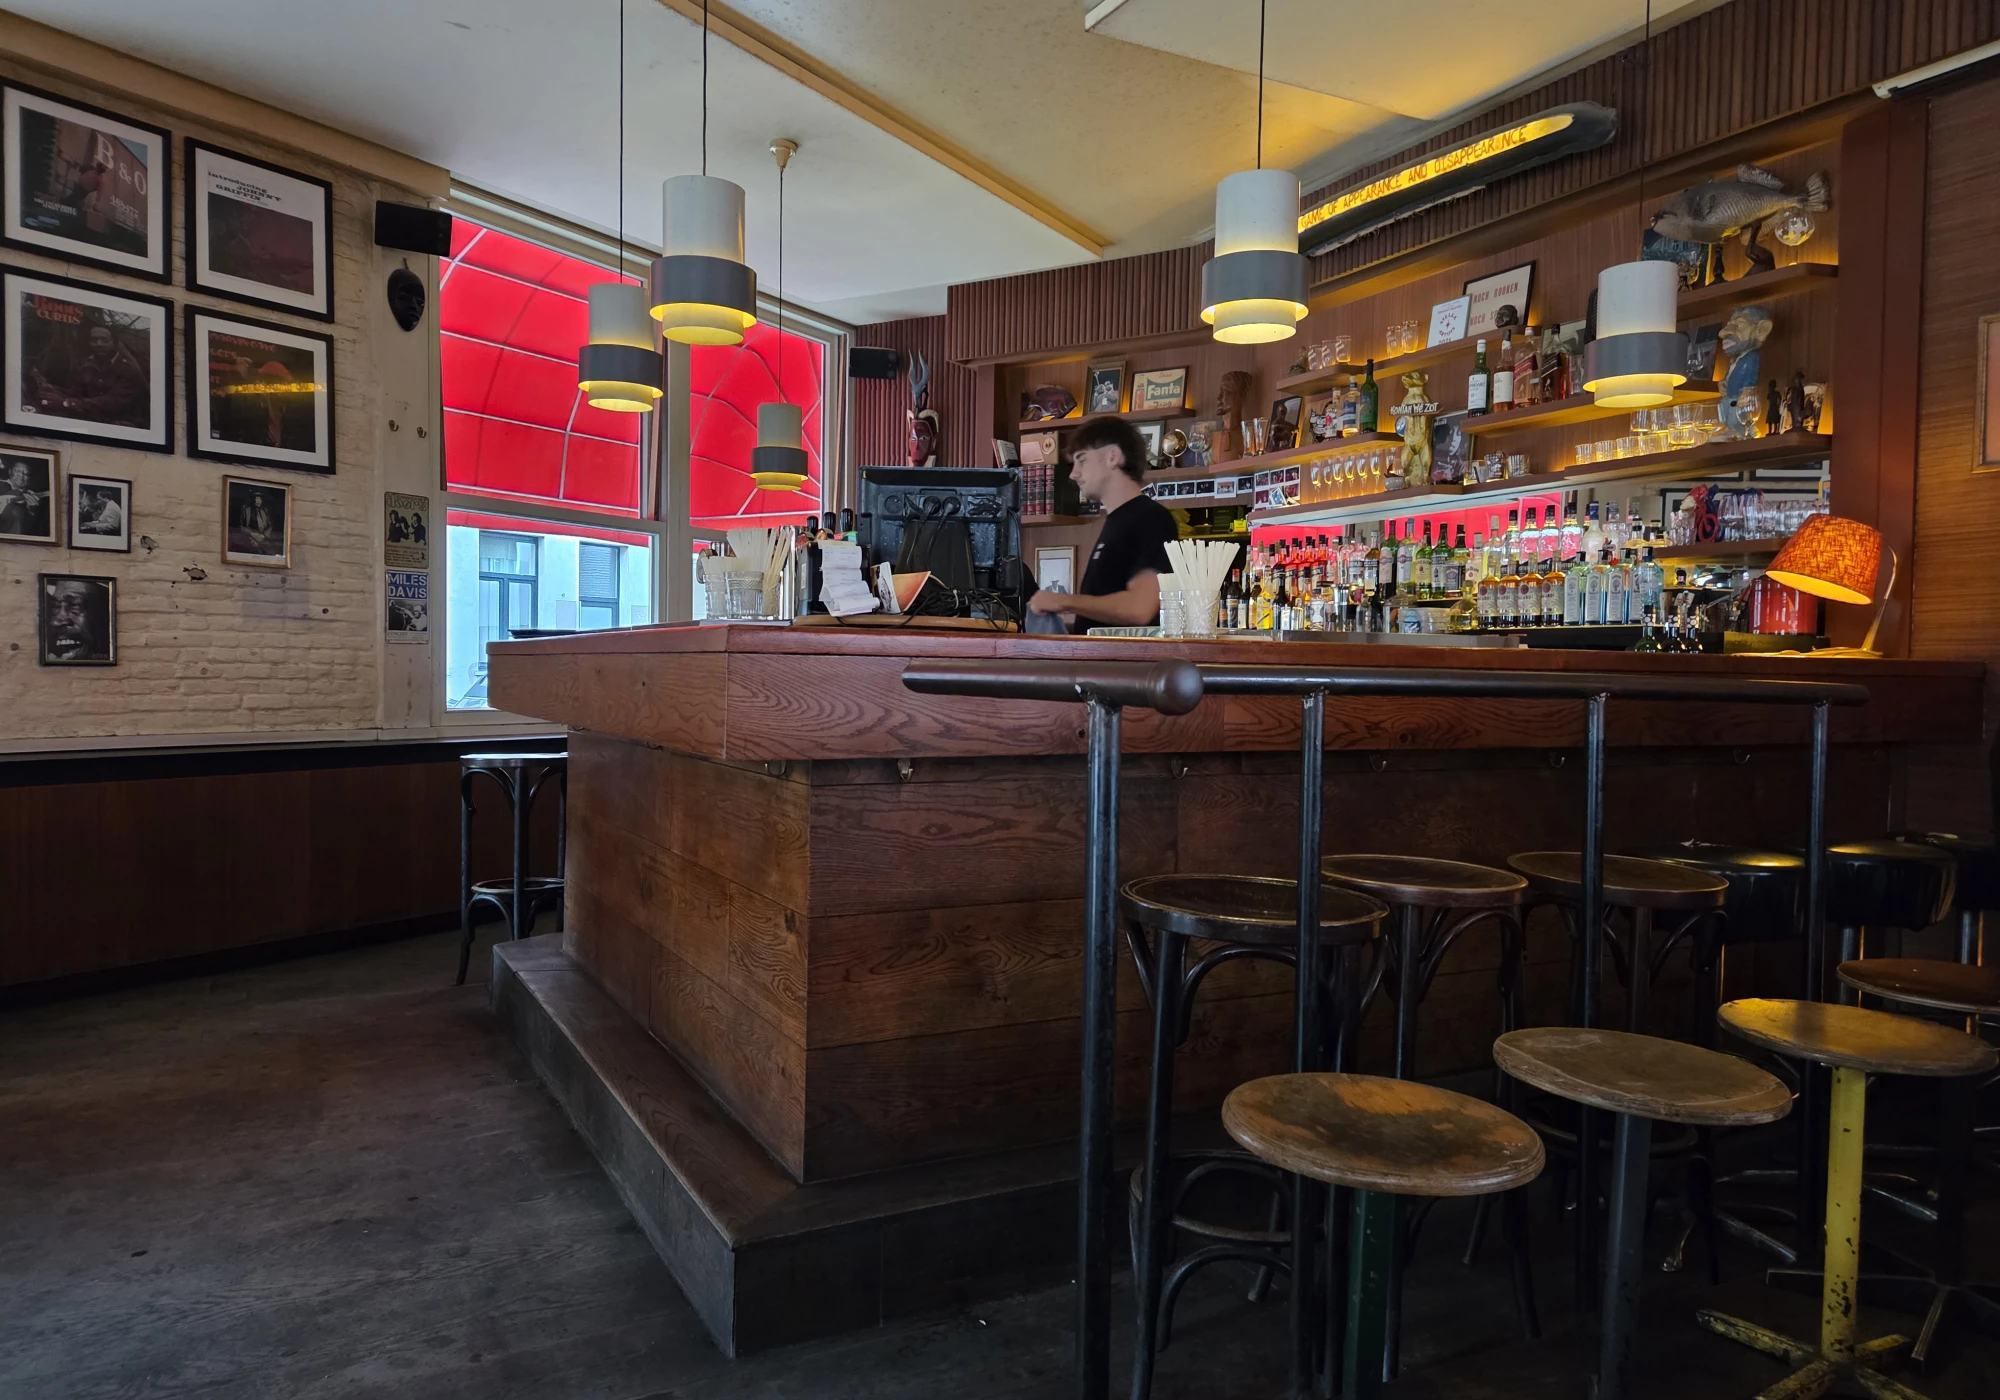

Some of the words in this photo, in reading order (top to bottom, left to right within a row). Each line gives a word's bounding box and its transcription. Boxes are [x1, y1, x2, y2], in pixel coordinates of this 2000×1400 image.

[94, 130, 115, 170] B
[134, 170, 147, 195] O
[215, 184, 261, 201] GRIFFIN
[236, 185, 282, 202] JOHNNY
[1301, 207, 1324, 228] GAME
[1328, 201, 1338, 215] OF
[1343, 174, 1402, 209] APPEARANCE
[1408, 164, 1428, 184] AND
[1473, 291, 1489, 304] NOCH
[1494, 282, 1519, 298] ROOKEN
[1439, 312, 1457, 324] STELLA
[1146, 382, 1181, 400] Fanta
[1424, 402, 1439, 412] ZOT
[388, 573, 427, 586] MILES
[388, 586, 427, 599] DAVIS
